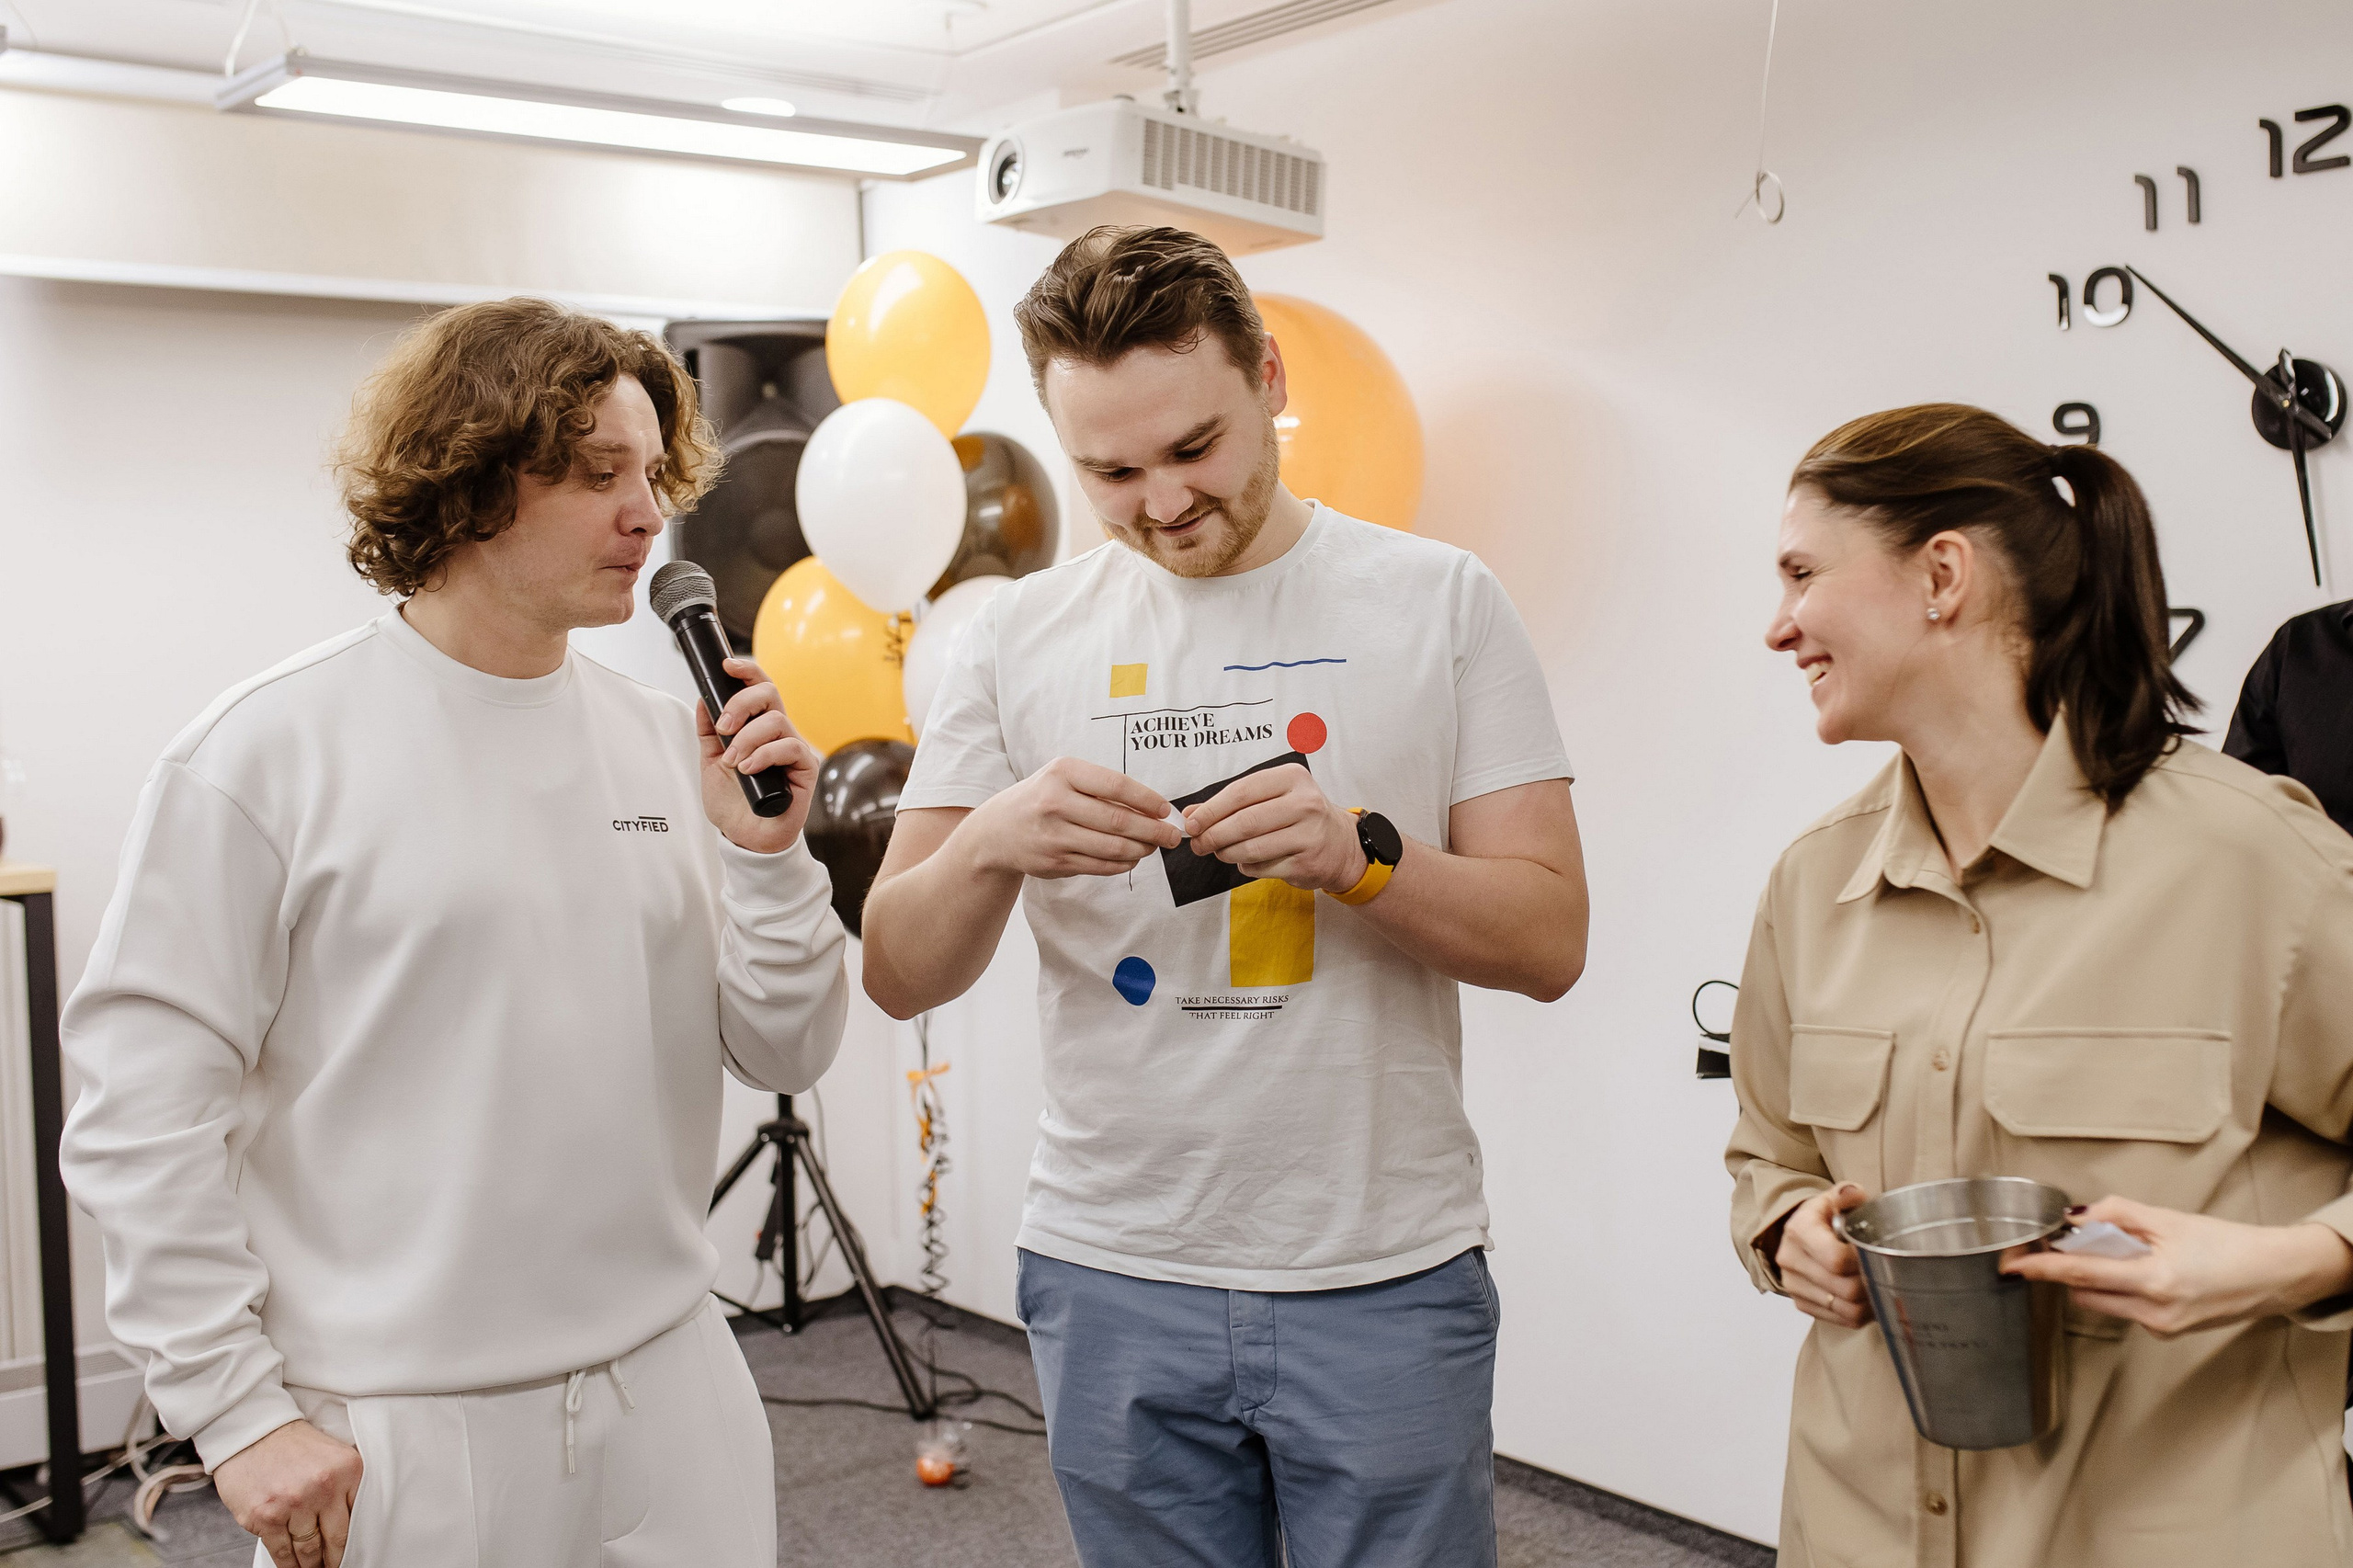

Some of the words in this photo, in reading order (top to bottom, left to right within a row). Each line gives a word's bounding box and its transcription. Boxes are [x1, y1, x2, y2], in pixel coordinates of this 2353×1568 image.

[2259, 104, 2351, 178] 12
[2134, 166, 2201, 232] 11
[2048, 267, 2133, 331] 10
[2052, 402, 2100, 446] 9
[1131, 713, 1215, 733] ACHIEVE
[1131, 733, 1188, 751] YOUR
[1194, 723, 1273, 747] DREAMS
[612, 820, 669, 833] CITYFIED
[1176, 996, 1200, 1005] TAKE
[1203, 995, 1260, 1005] NECESSARY
[1262, 994, 1290, 1004] RISKS
[1189, 1012, 1218, 1020] THAT
[1243, 1011, 1275, 1020] RIGHT
